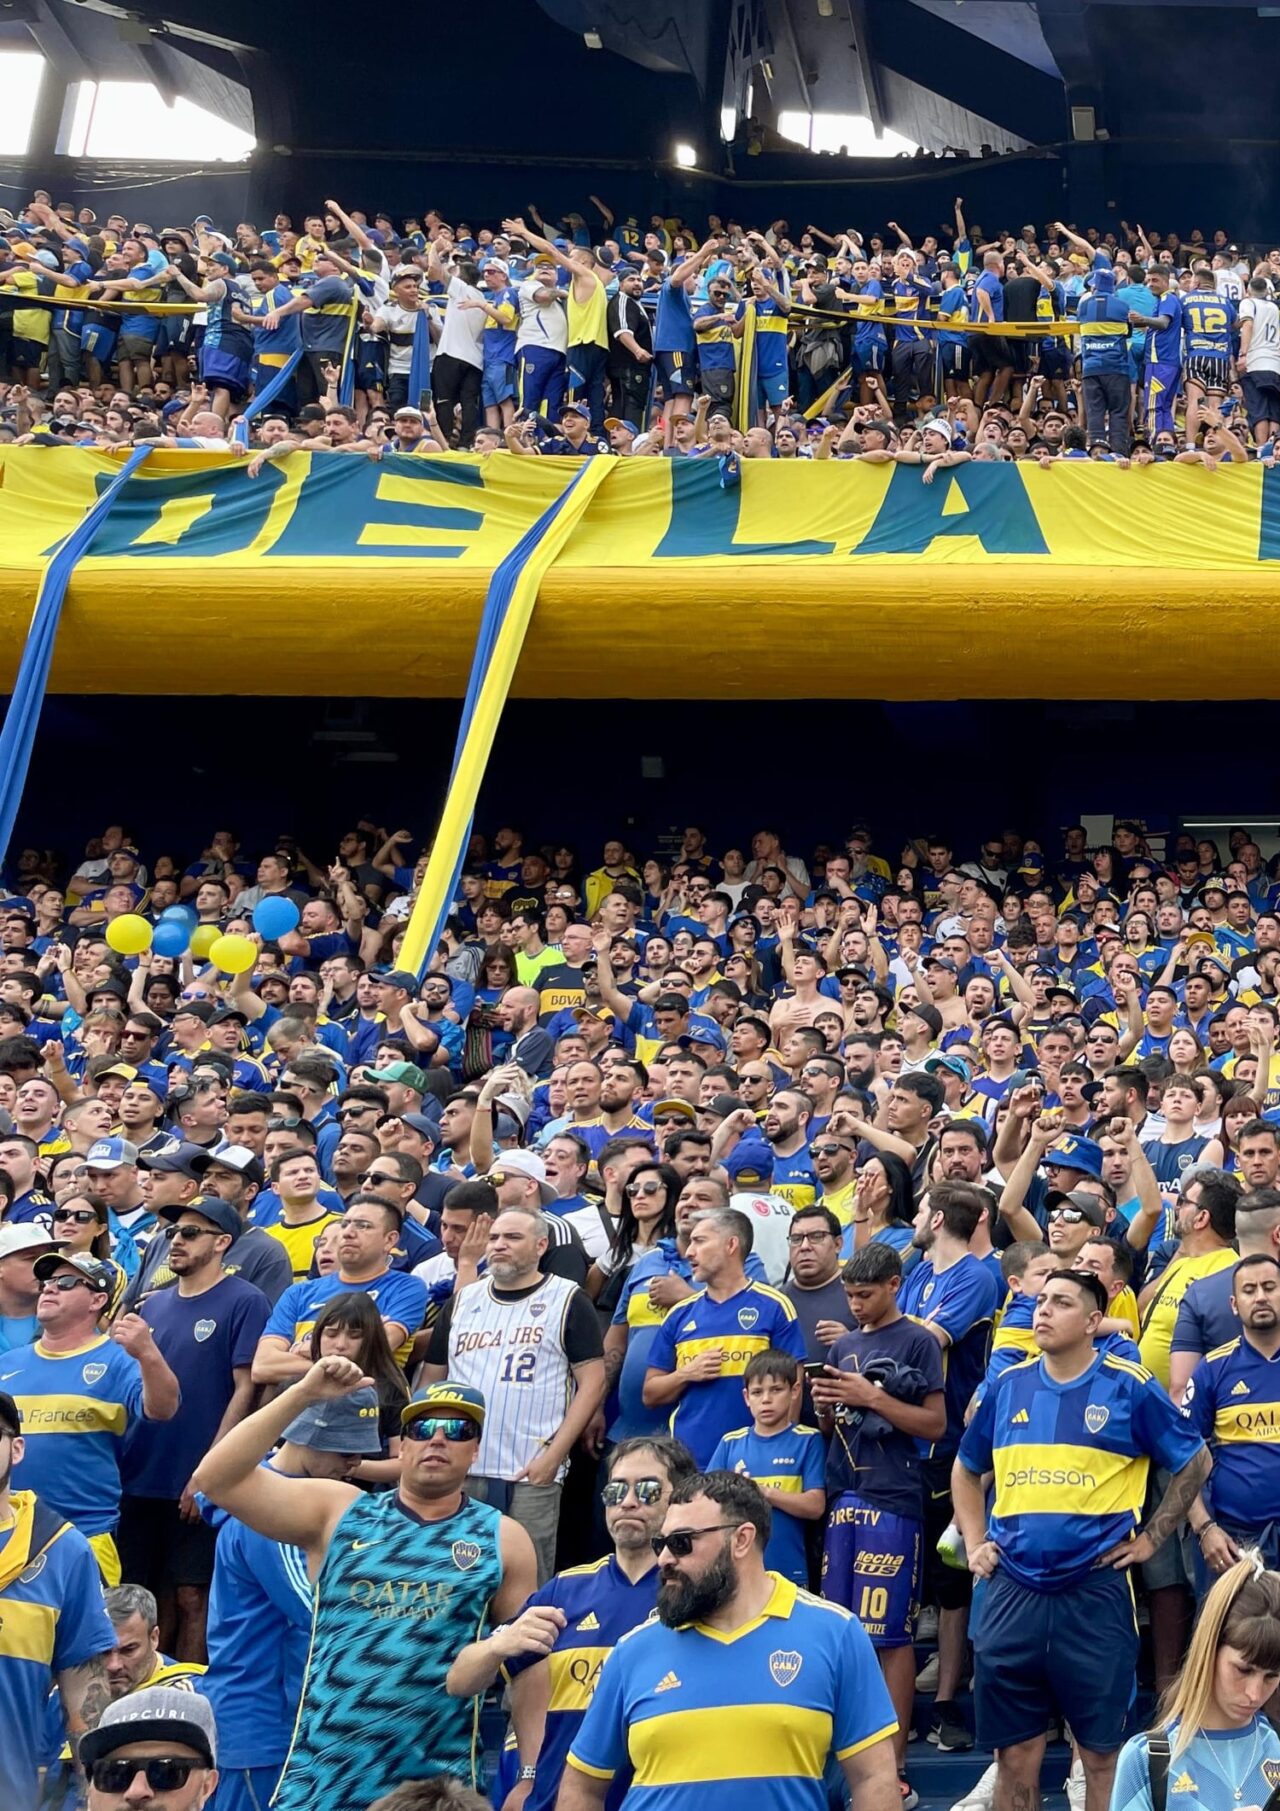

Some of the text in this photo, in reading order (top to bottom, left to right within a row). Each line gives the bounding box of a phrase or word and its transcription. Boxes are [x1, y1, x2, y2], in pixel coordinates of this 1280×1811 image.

[623, 229, 639, 247] 12
[1225, 284, 1238, 300] 12
[1188, 307, 1227, 334] 12
[1265, 323, 1276, 344] 12
[42, 453, 485, 558] DE
[653, 457, 1050, 558] LA
[551, 995, 583, 1007] BBVA
[772, 1203, 792, 1218] LG
[454, 1326, 544, 1358] BOCA JRS
[500, 1352, 537, 1383] 12
[429, 1389, 464, 1403] CABJ
[28, 1407, 96, 1424] Francés
[854, 1561, 900, 1577] BUS
[346, 1580, 456, 1606] QATAR
[859, 1586, 888, 1619] 10
[862, 1623, 887, 1635] NEIZE
[772, 1661, 797, 1671] CABJ
